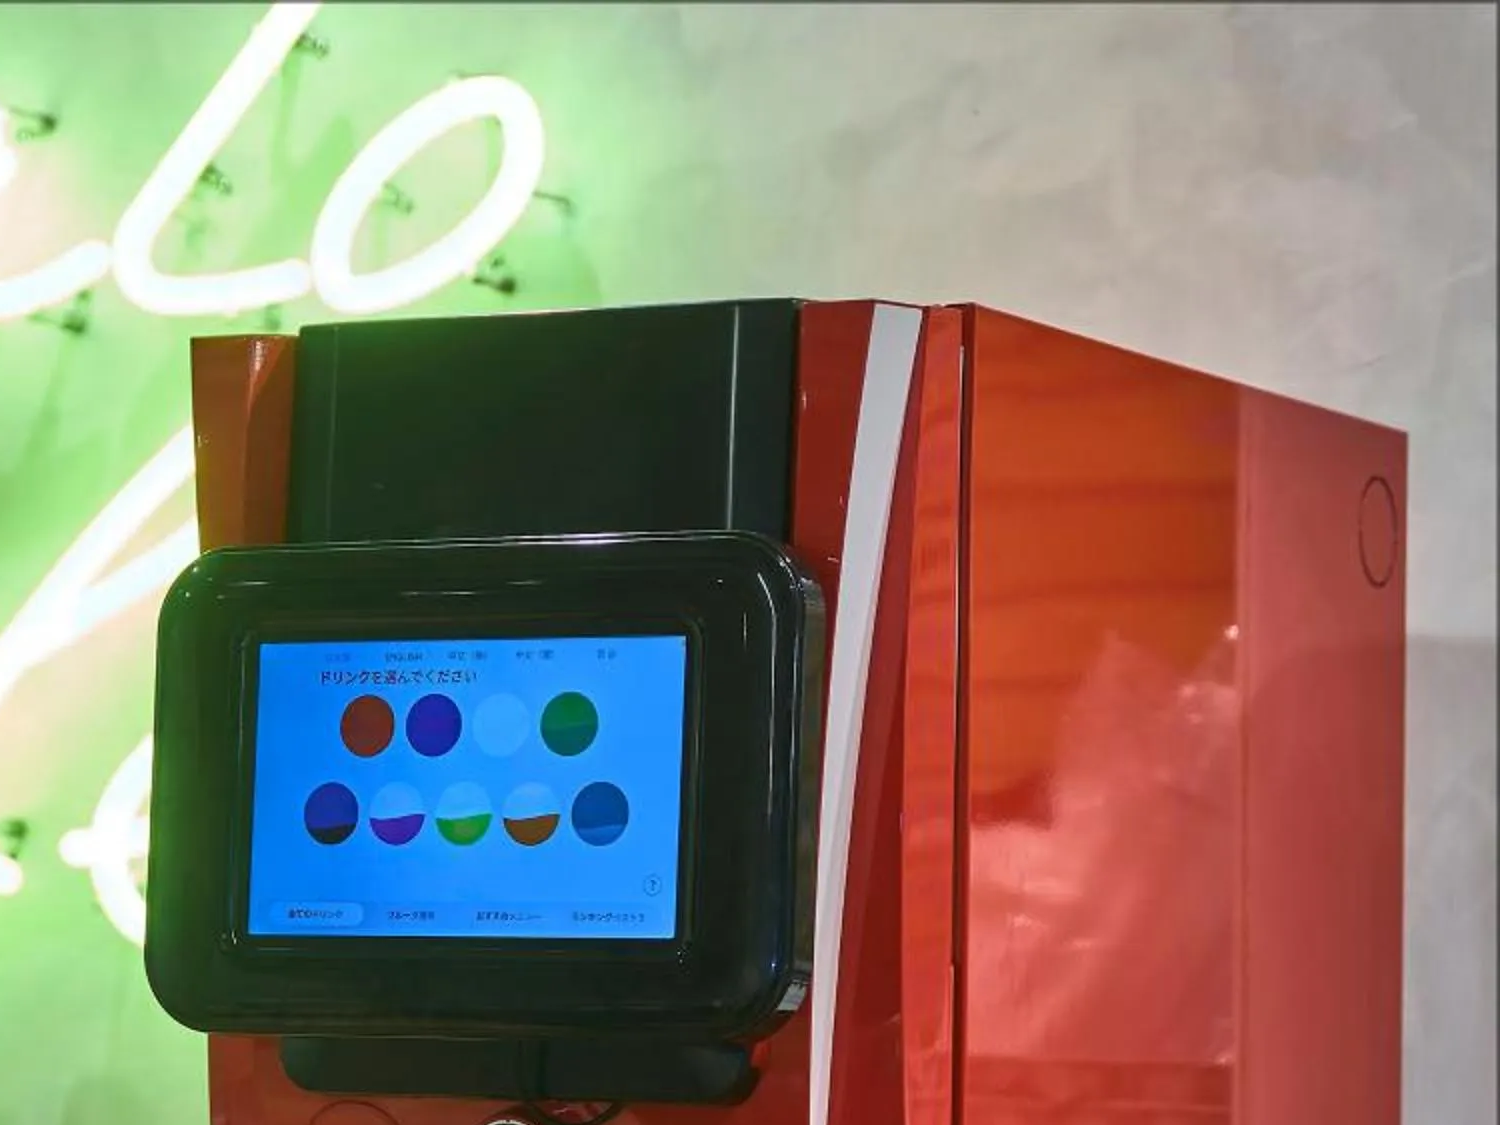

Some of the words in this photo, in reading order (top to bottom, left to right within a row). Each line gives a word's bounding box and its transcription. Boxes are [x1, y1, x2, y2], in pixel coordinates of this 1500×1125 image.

[321, 669, 477, 685] ドリンクを選んでください
